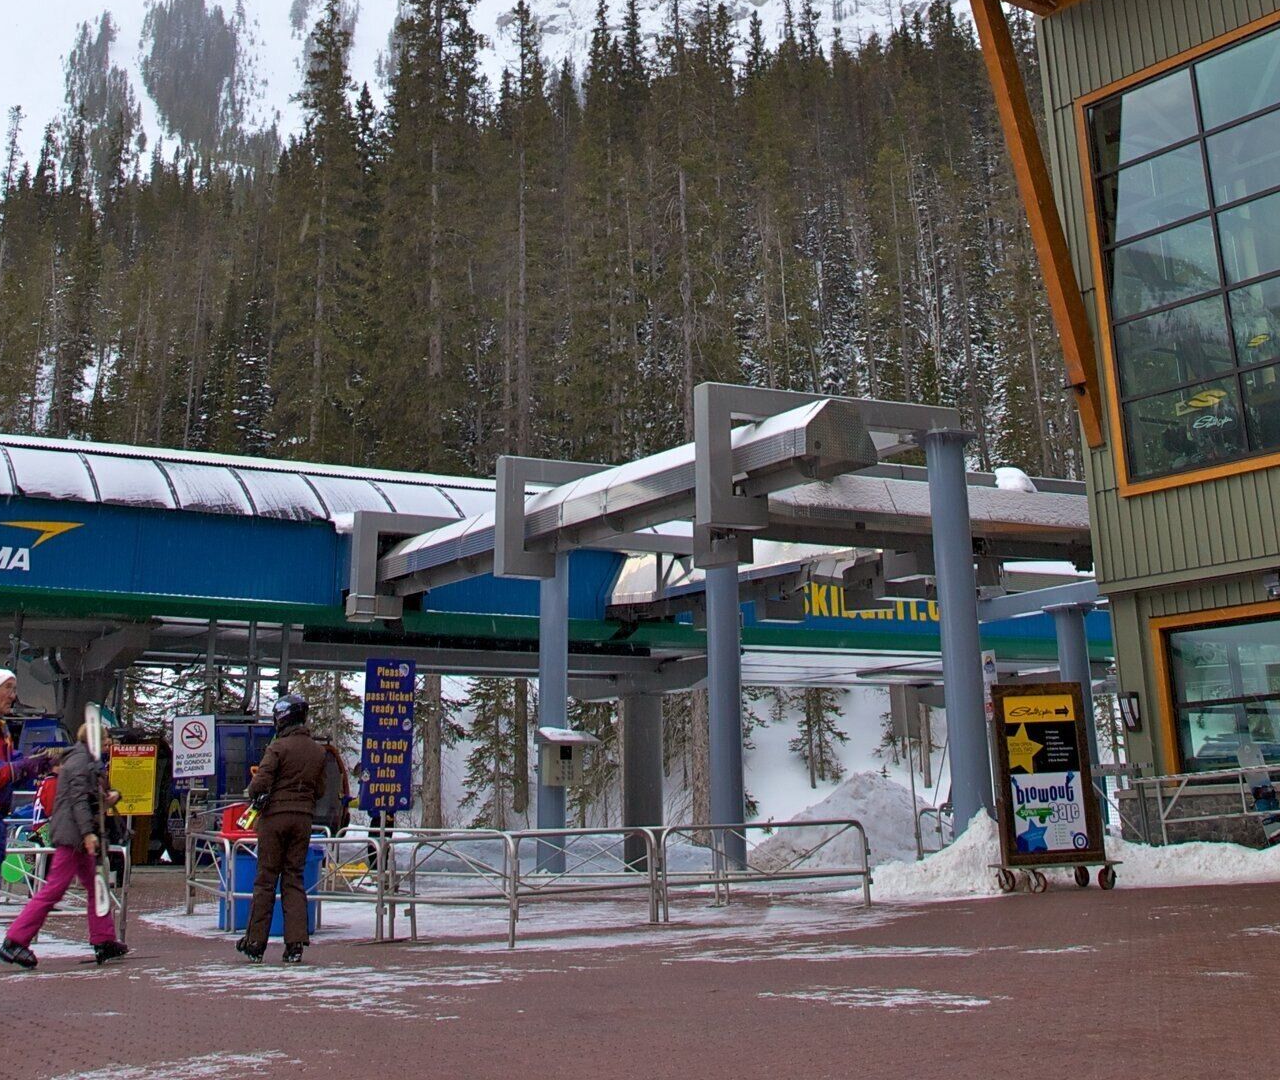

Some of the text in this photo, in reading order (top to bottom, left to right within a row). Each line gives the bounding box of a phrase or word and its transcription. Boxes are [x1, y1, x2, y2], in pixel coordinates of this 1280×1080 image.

[380, 679, 400, 689] have
[365, 691, 413, 703] pass/ticket
[371, 703, 407, 715] ready to
[378, 716, 398, 726] scan
[366, 738, 408, 751] Be ready
[371, 753, 404, 764] to load
[376, 767, 396, 778] into
[370, 782, 401, 795] groups
[1015, 783, 1074, 804] blowout
[388, 796, 395, 807] 8
[1048, 801, 1080, 823] Sale
